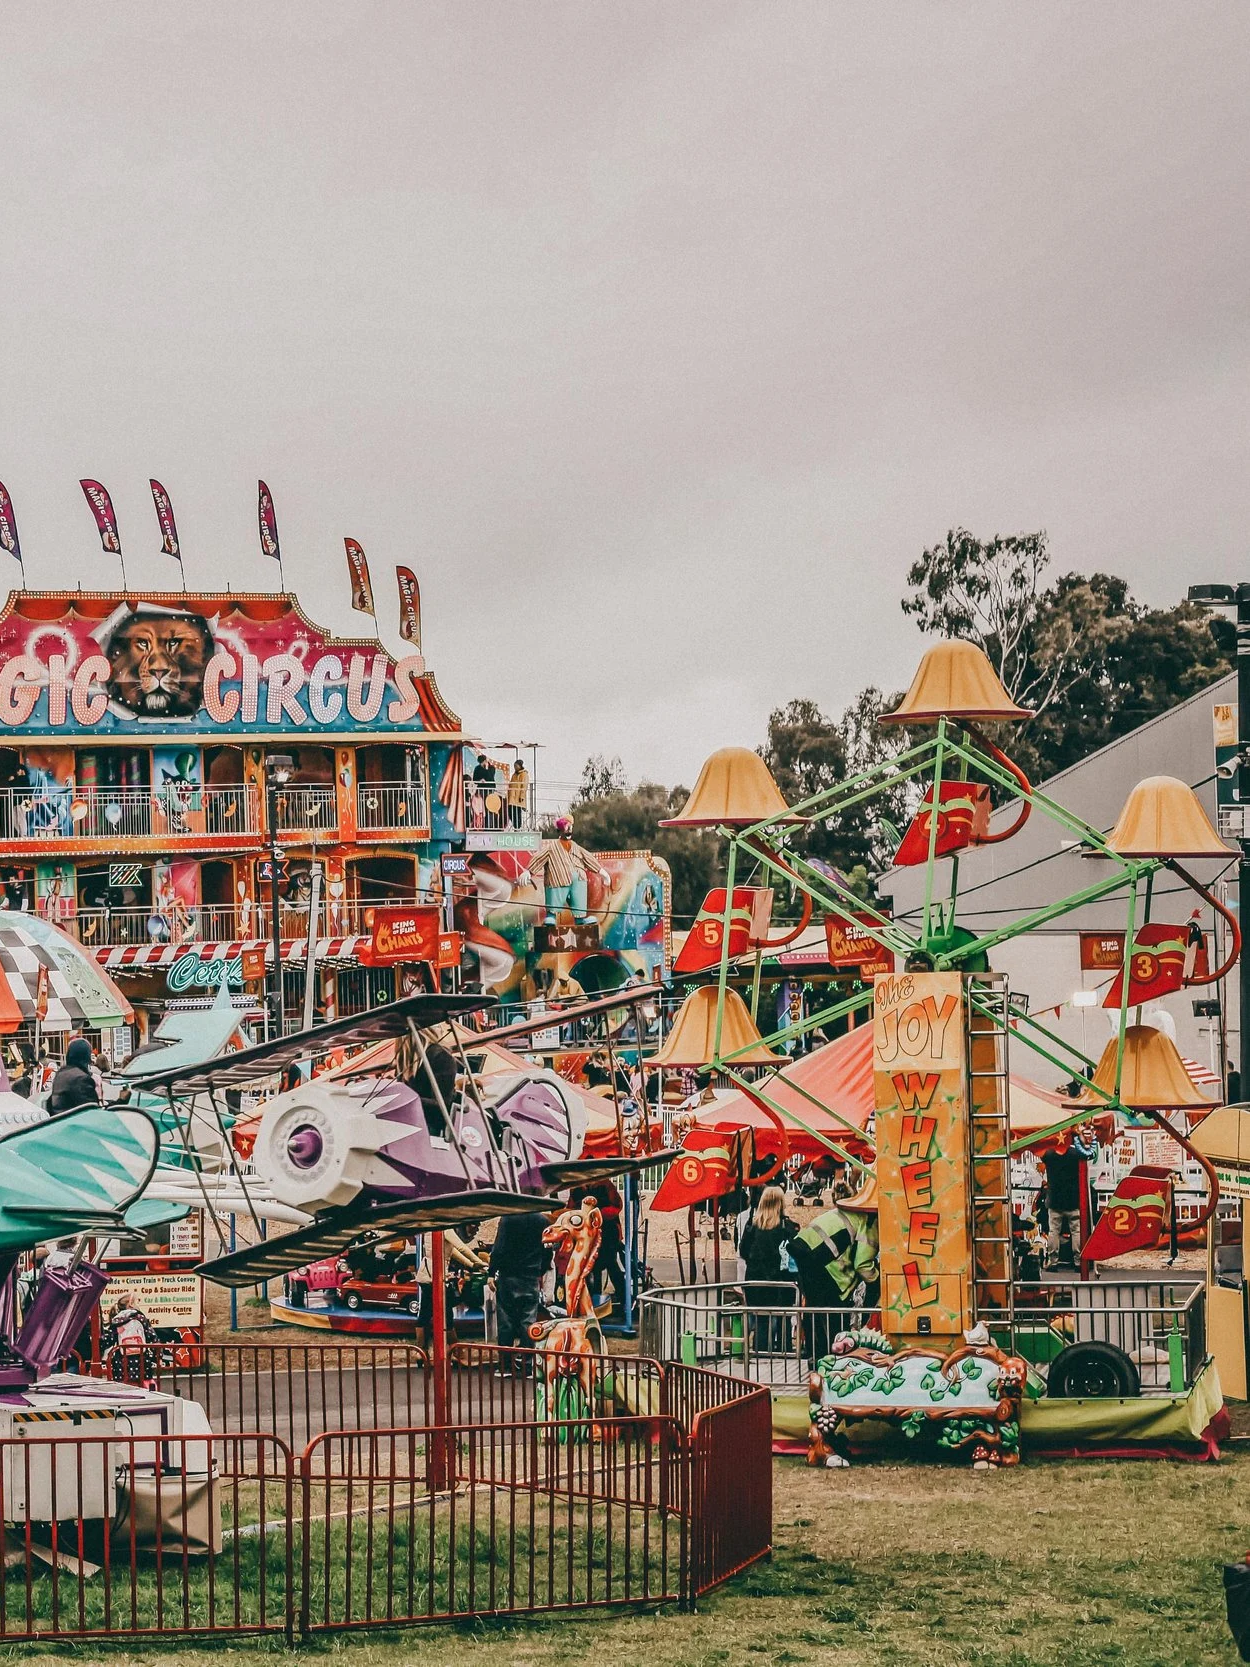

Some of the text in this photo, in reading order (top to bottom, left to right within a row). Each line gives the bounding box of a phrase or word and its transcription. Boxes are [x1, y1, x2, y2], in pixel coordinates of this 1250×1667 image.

[87, 486, 120, 551] MAGIC CIRCUS
[152, 488, 178, 555] MAGIC CIRCUS
[0, 515, 16, 551] CIRCUS
[261, 520, 278, 554] CIRCUS
[399, 575, 413, 604] MAGIC
[203, 653, 426, 726] CIRCUS
[497, 836, 535, 847] HOUSE
[443, 859, 466, 871] CIRCUS
[392, 920, 416, 930] KING
[399, 926, 417, 935] FUN
[704, 923, 719, 944] 5
[376, 922, 424, 954] CHANTS
[830, 927, 876, 958] CHANTS
[1136, 955, 1153, 978] 3
[876, 994, 959, 1063] JOY
[683, 1160, 698, 1182] 6
[891, 1071, 941, 1310] WHEEL
[1114, 1208, 1130, 1230] 2
[141, 1287, 153, 1295] Cup
[181, 1285, 196, 1293] Ride
[177, 1276, 196, 1284] Convoy
[148, 1306, 171, 1314] Activity
